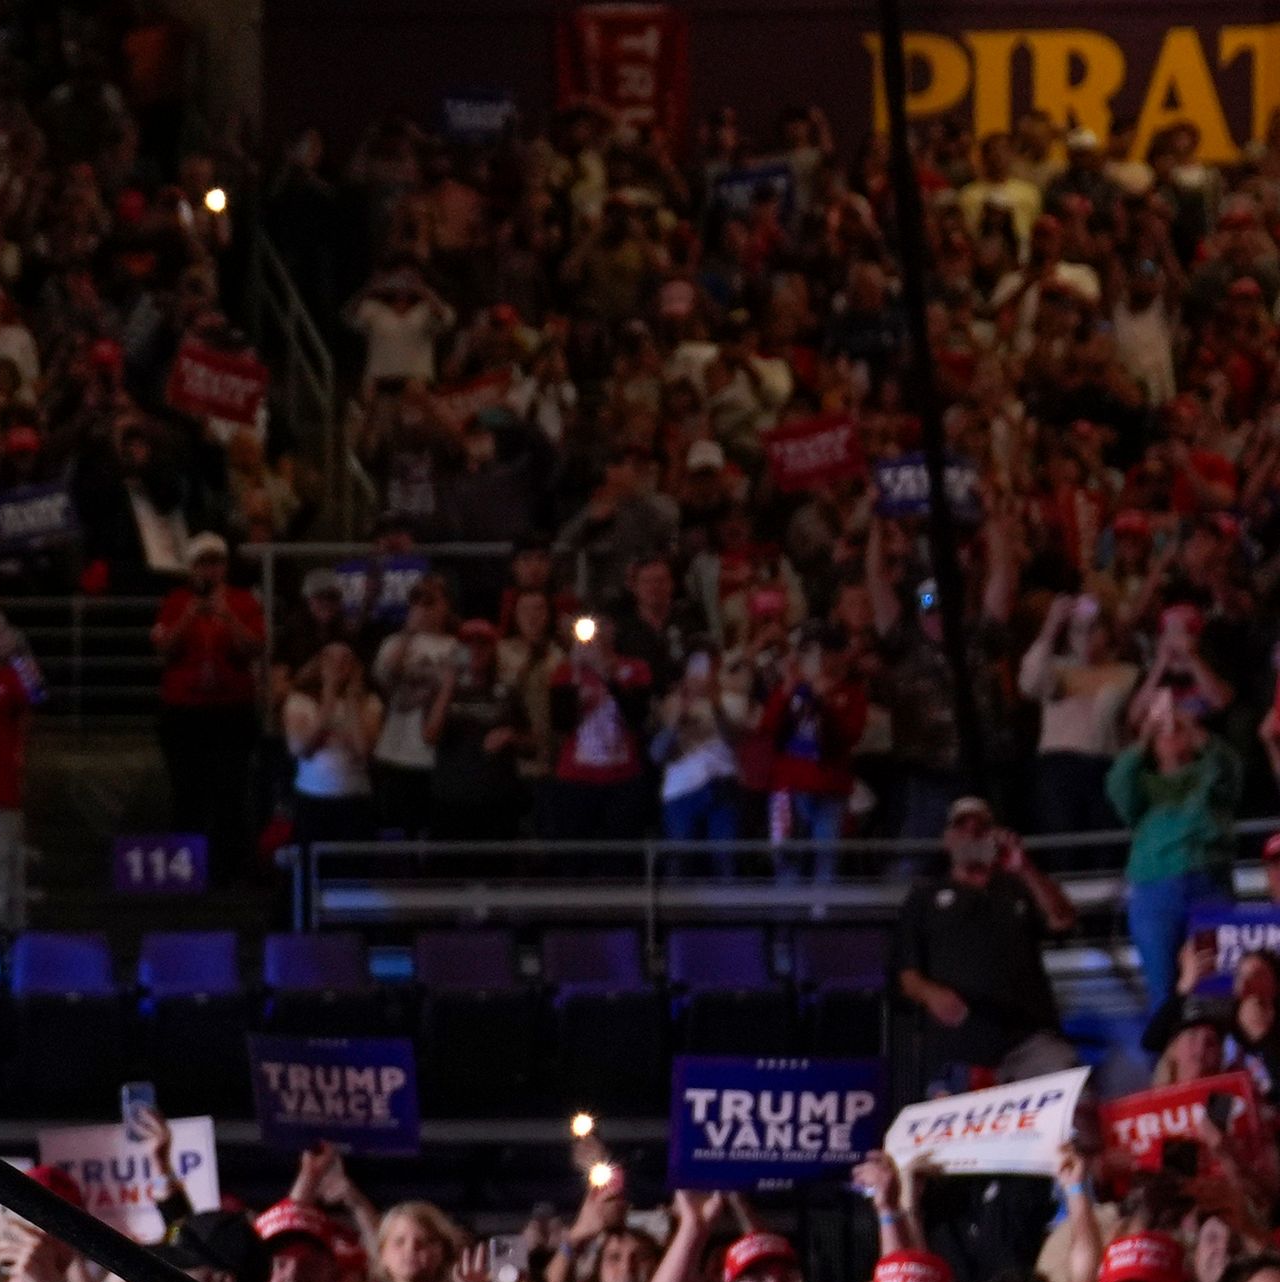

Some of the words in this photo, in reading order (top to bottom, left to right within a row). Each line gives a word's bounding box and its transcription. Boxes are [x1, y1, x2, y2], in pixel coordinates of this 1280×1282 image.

[125, 846, 194, 883] 114
[261, 1062, 407, 1092] TRUMP
[279, 1090, 391, 1118] VANCE
[684, 1087, 876, 1124] TRUMP
[906, 1089, 1063, 1136] TRUMP
[704, 1120, 855, 1150] VANCE
[913, 1114, 1037, 1146] VANCE
